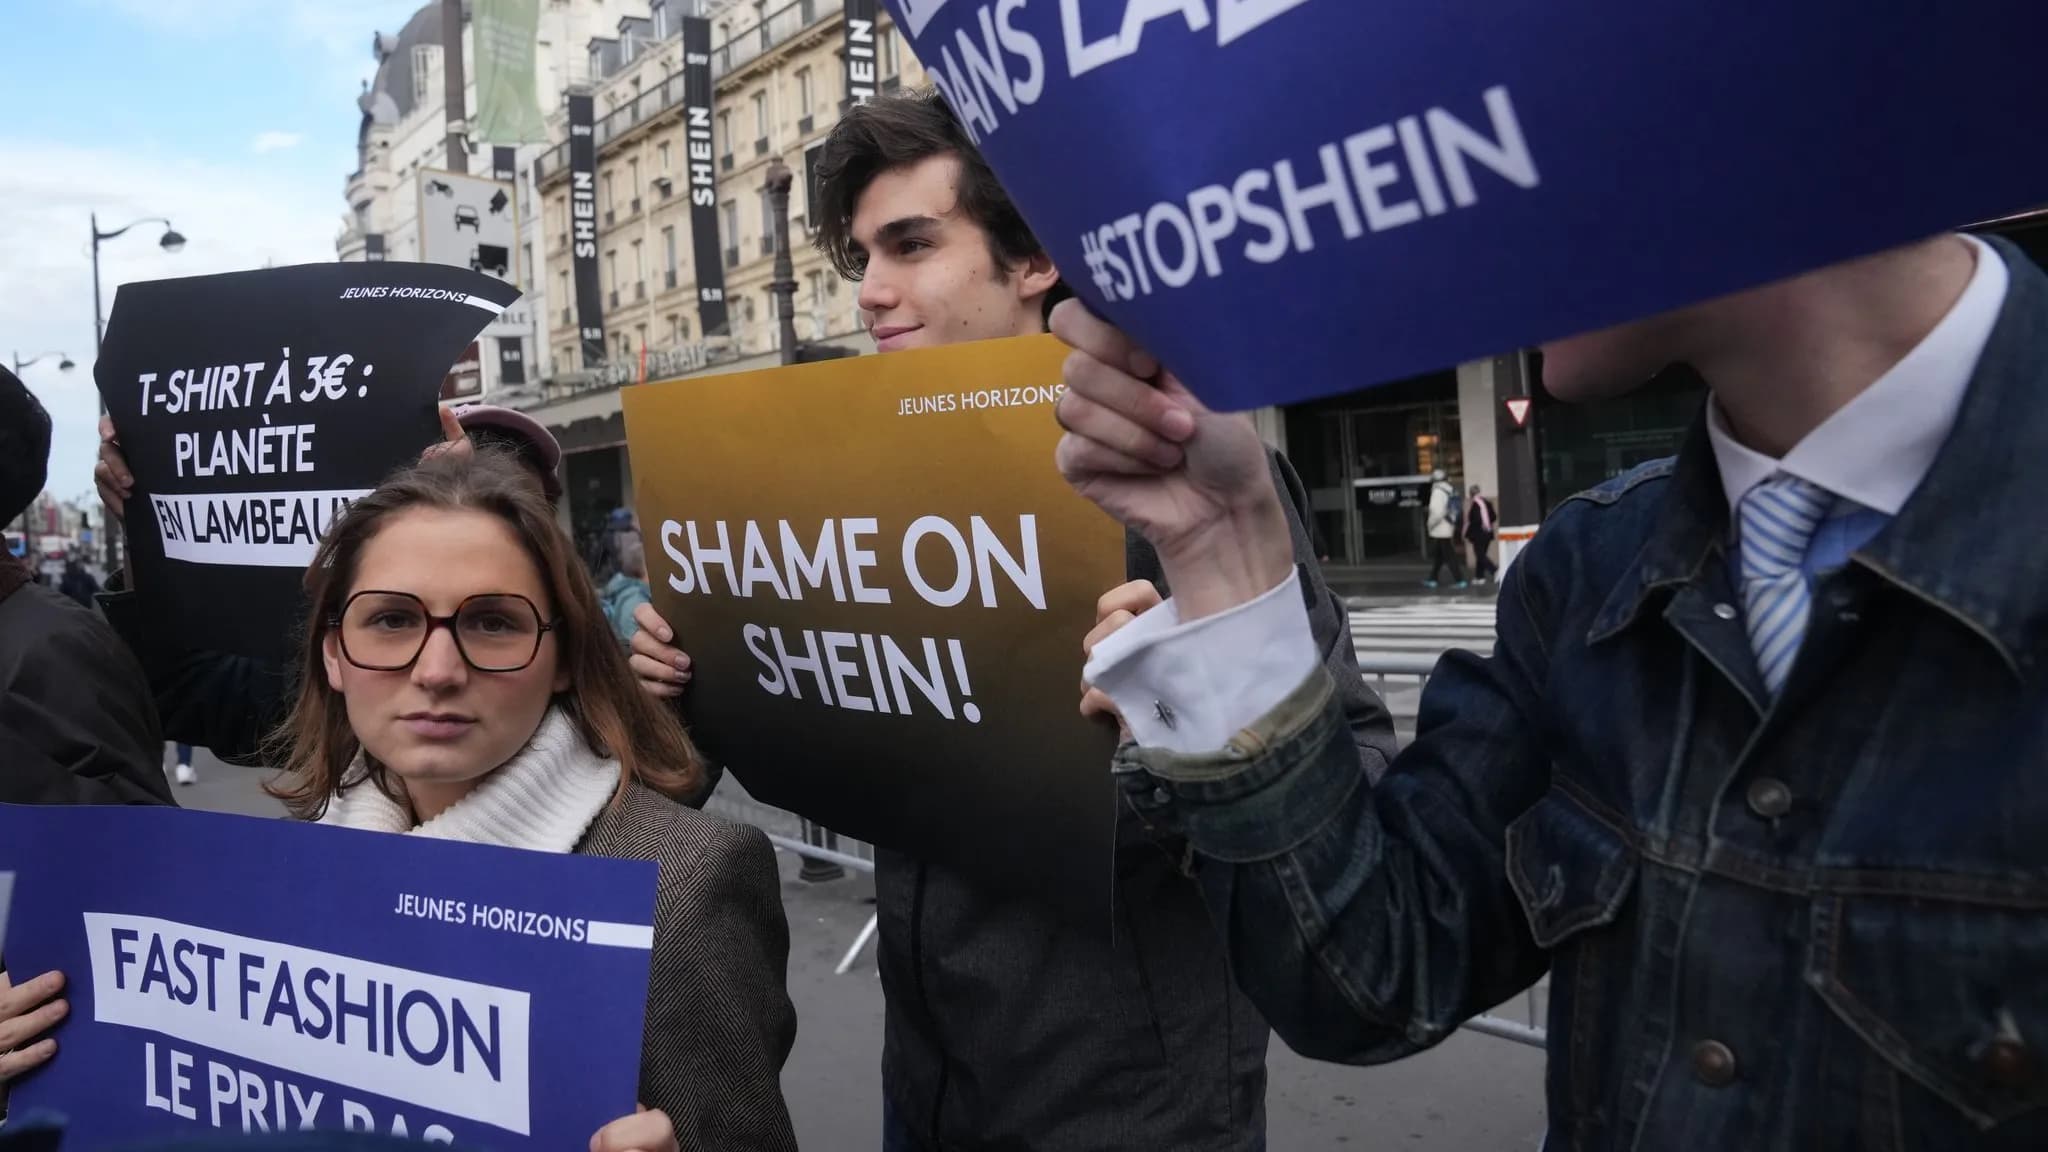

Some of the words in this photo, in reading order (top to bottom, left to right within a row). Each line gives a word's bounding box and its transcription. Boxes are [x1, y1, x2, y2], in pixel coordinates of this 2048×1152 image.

[849, 19, 875, 106] HEIN
[688, 107, 714, 206] SHEIN
[1081, 86, 1540, 303] #STOPSHEIN
[573, 172, 595, 258] SHEIN
[340, 286, 388, 299] JEUNES
[389, 288, 467, 305] HORIZONS
[139, 362, 264, 416] T-SHIRT
[264, 347, 291, 405] À
[898, 393, 957, 416] JEUNES
[961, 383, 1066, 410] HORIZONS
[175, 413, 316, 477] PLANÈTE
[156, 500, 187, 542] EN
[188, 496, 350, 545] LAMBEAU
[661, 518, 891, 604] SHAME
[902, 514, 1047, 610] ON
[743, 623, 981, 724] SHEIN!
[395, 893, 466, 924] JEUNES
[472, 904, 586, 942] HORIZONS
[111, 928, 225, 1011] FAST
[239, 952, 501, 1082] FASHION
[146, 1042, 197, 1120] LE
[208, 1060, 324, 1135] PRIX
